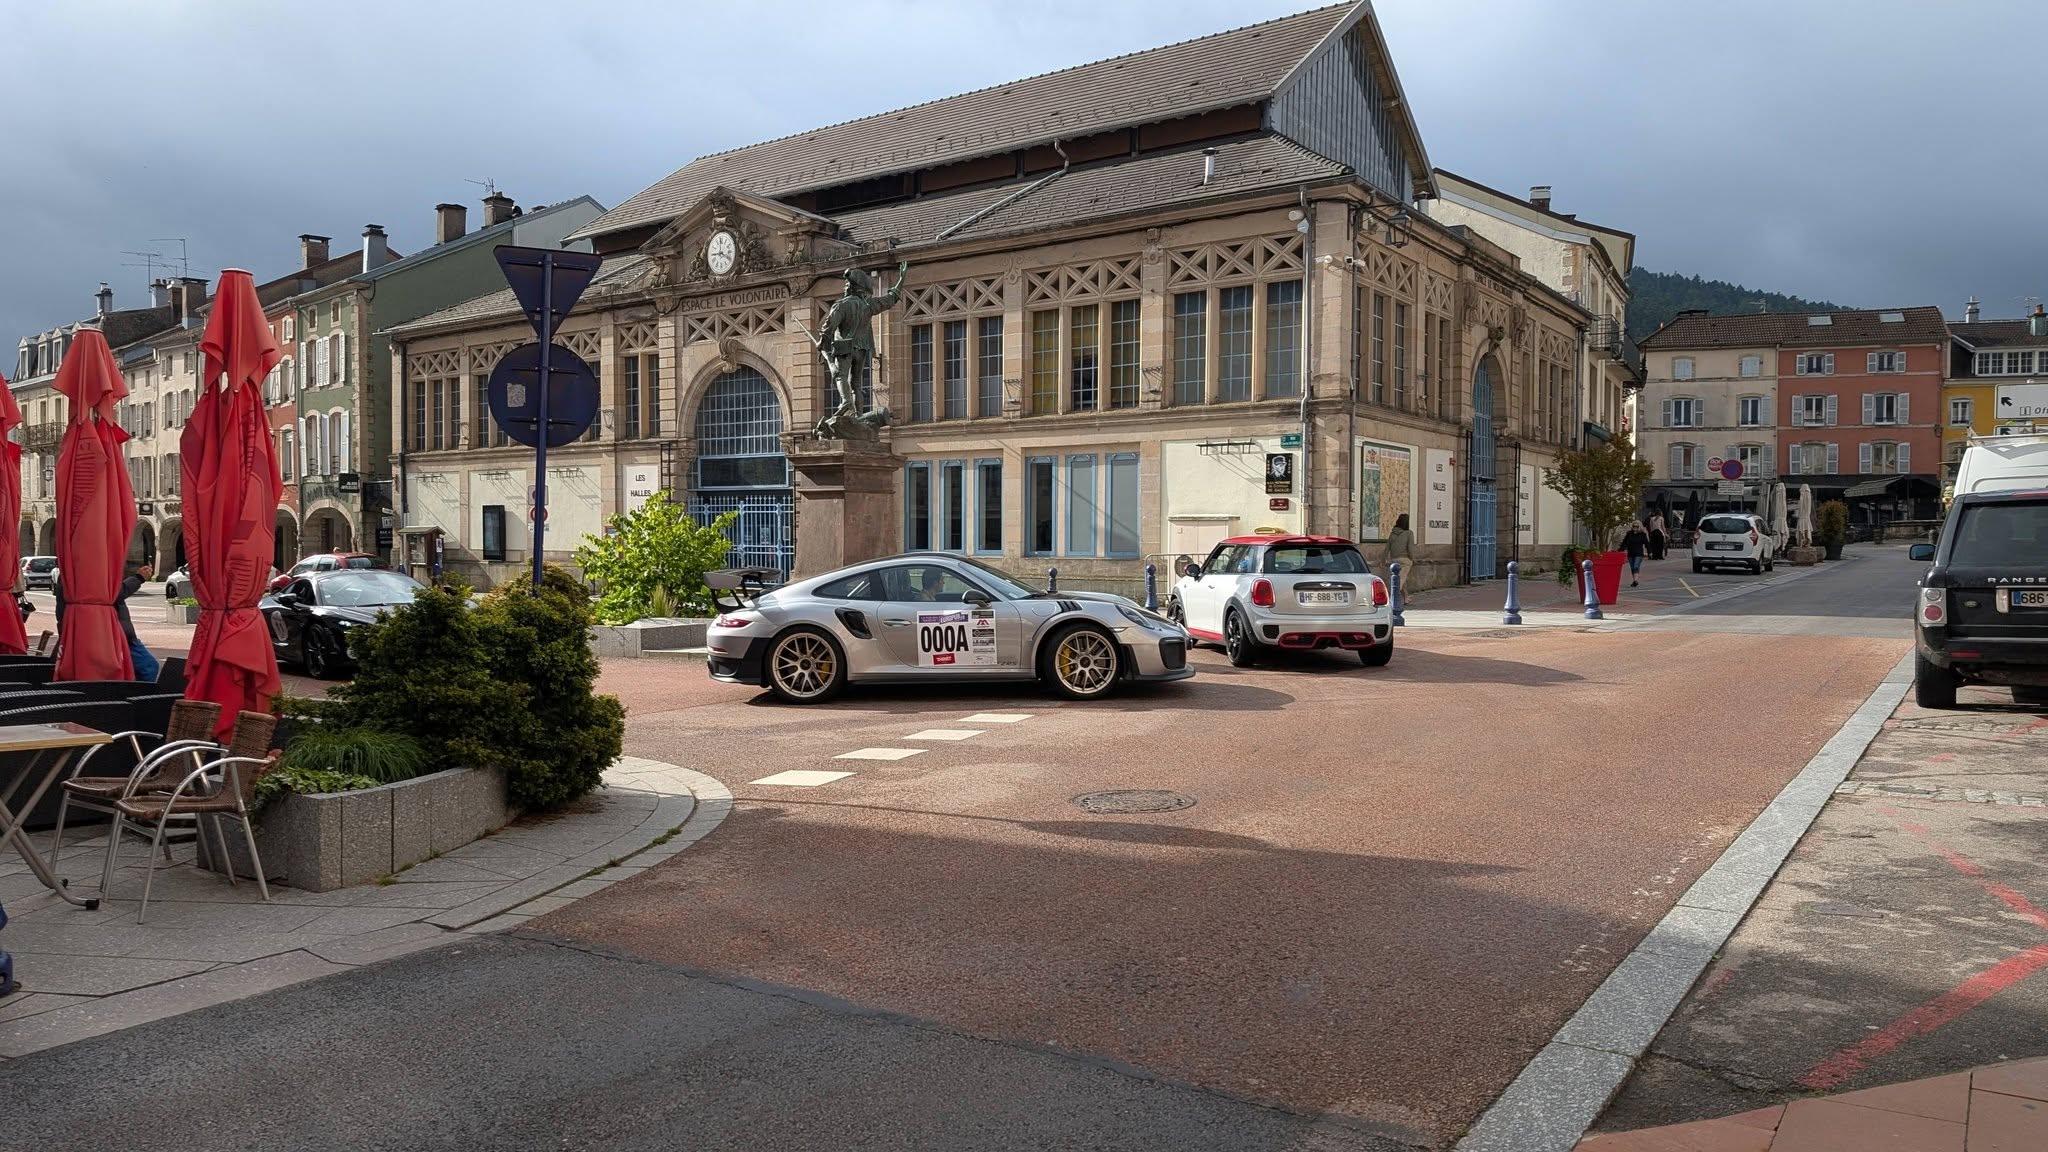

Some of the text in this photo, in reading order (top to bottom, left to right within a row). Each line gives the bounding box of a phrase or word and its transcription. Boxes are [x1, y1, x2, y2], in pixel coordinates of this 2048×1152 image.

[681, 287, 787, 313] ESPACE LE VOLONTAIRE
[635, 474, 646, 482] LES
[1433, 482, 1446, 492] HALLES
[630, 489, 651, 497] HALLES
[1437, 501, 1442, 510] LE
[1429, 520, 1450, 529] VOLONTAIRE
[2021, 592, 2048, 604] 686
[920, 624, 970, 653] 000A
